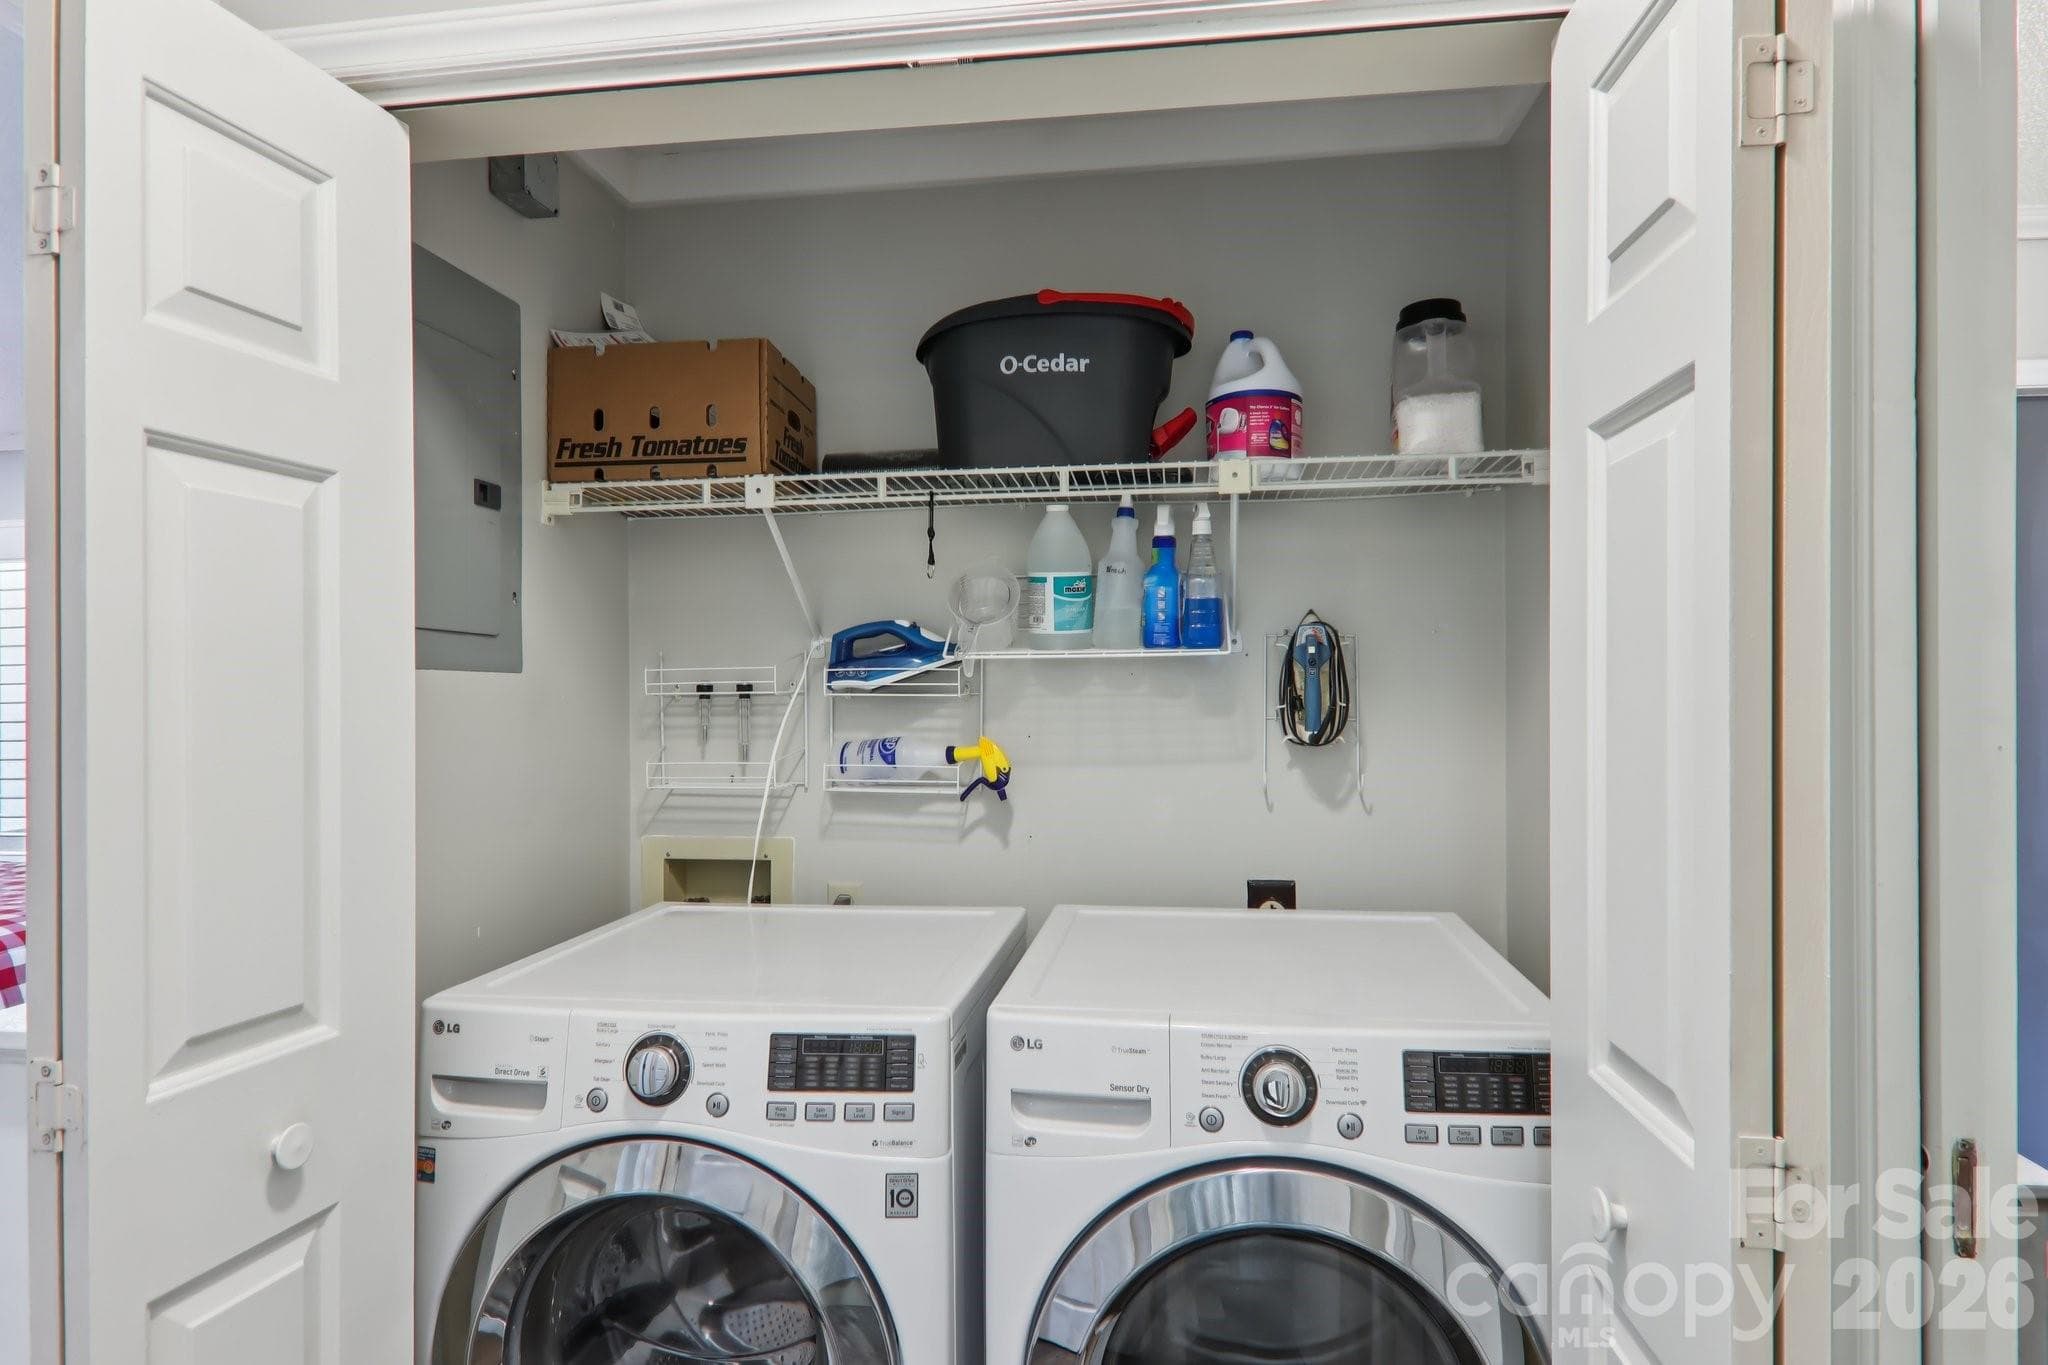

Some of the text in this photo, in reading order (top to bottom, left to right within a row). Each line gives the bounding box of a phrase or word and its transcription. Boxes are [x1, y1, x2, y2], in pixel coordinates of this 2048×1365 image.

[1000, 353, 1089, 374] O-Cedar
[555, 435, 748, 459] Fresh Tomatoes
[447, 1023, 460, 1033] LG
[1027, 1039, 1043, 1050] LG
[495, 1067, 513, 1076] Direct
[514, 1069, 530, 1077] Drive
[1109, 1083, 1150, 1094] Sensor Dry
[890, 1189, 914, 1208] 10
